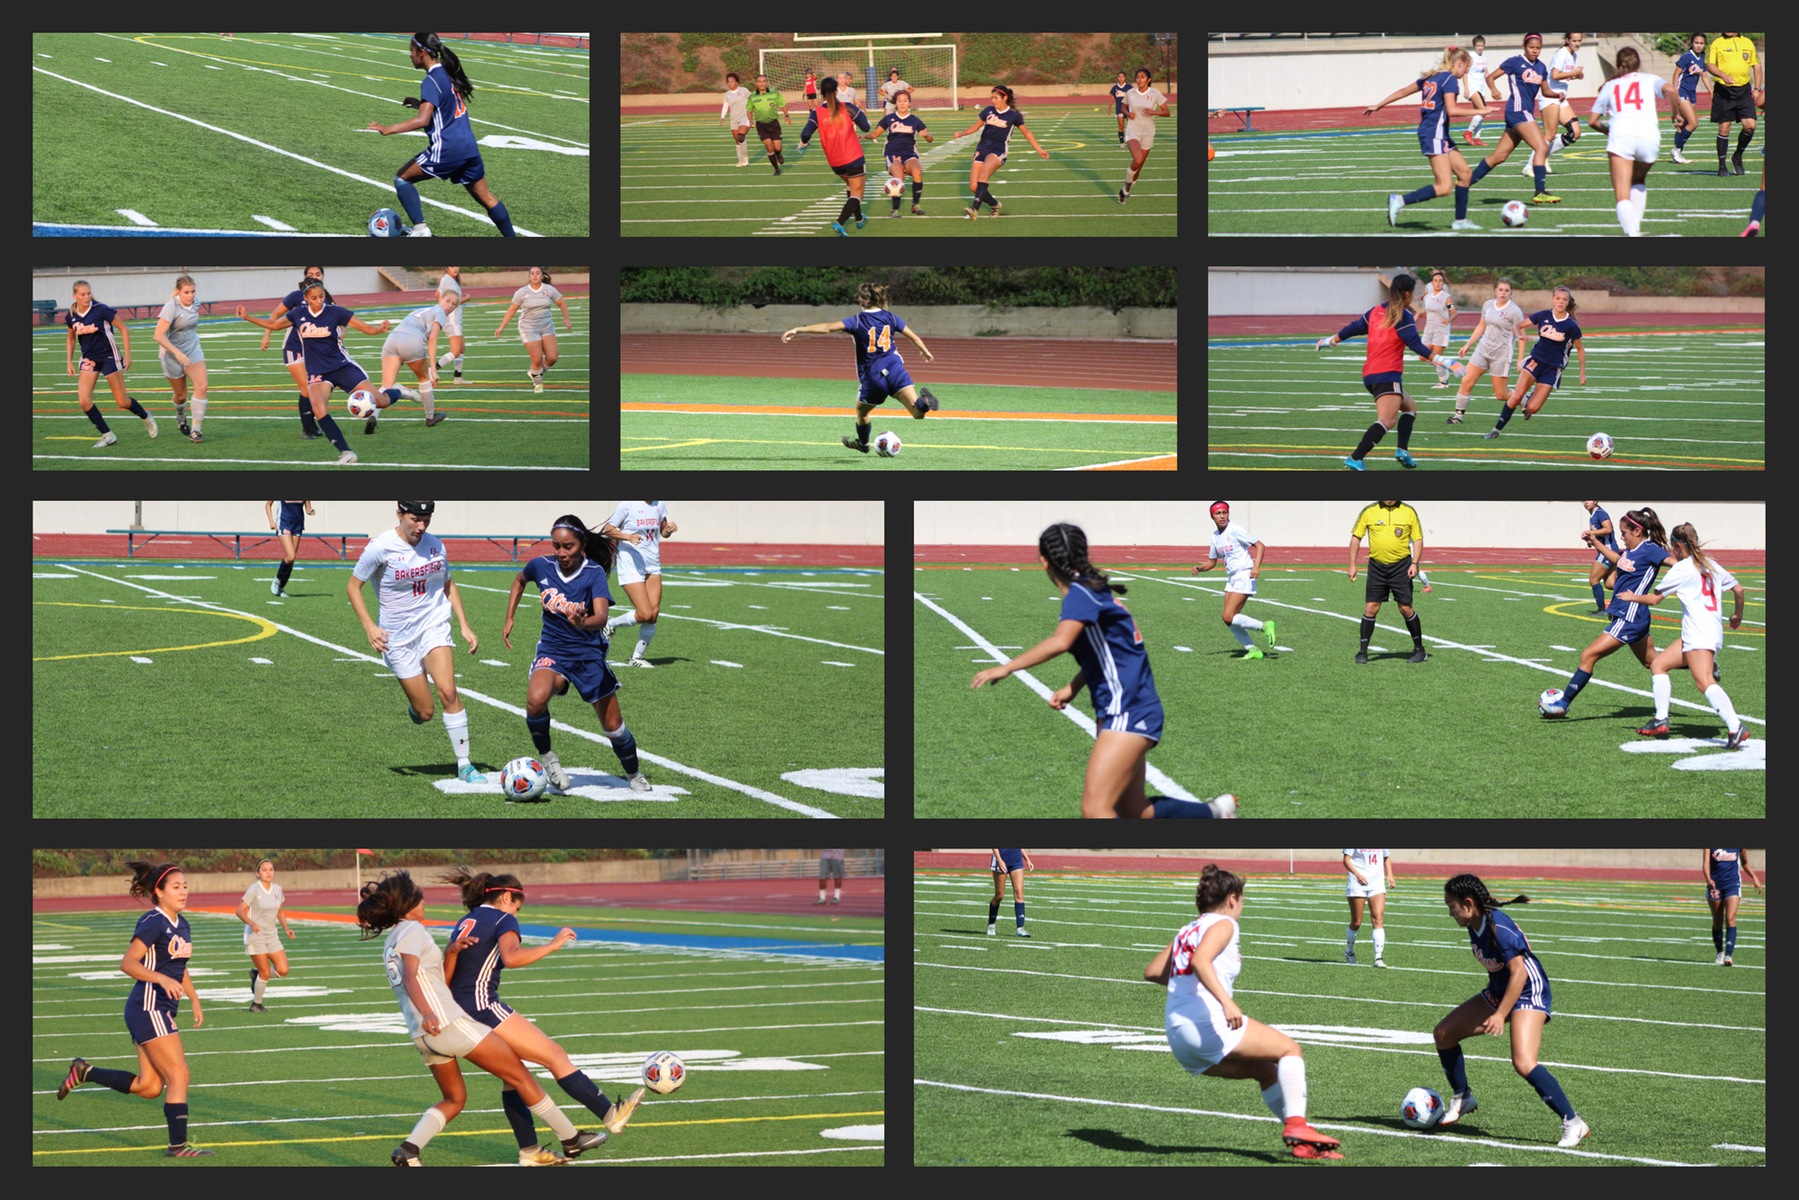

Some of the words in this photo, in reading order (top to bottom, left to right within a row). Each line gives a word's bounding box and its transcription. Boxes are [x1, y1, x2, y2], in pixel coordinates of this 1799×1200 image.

[1613, 81, 1644, 112] 14
[867, 325, 892, 353] 14
[412, 579, 427, 597] 10
[540, 587, 586, 614] Citrus
[1701, 572, 1718, 612] 9
[1368, 854, 1378, 866] 14
